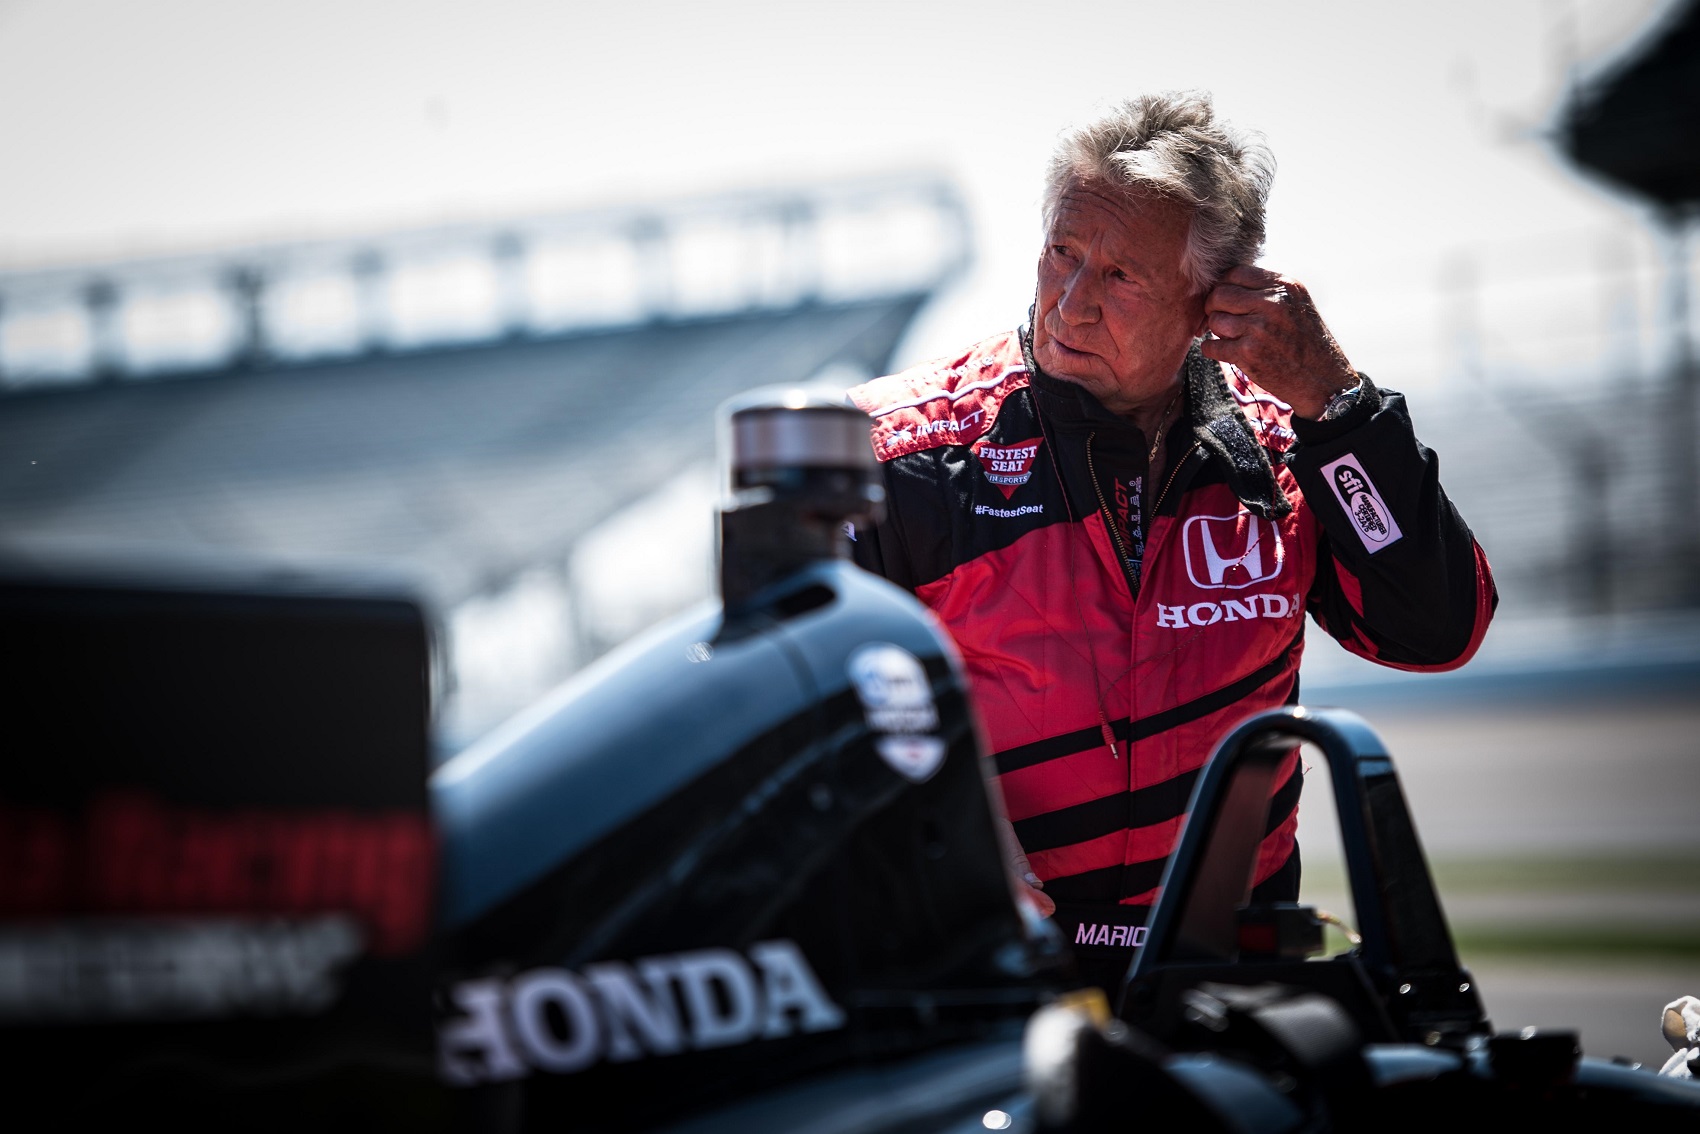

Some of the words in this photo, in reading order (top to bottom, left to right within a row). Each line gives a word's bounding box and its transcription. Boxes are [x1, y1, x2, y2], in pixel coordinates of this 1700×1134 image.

[916, 408, 985, 437] IMPACT
[979, 445, 1038, 461] FASTEST
[990, 459, 1026, 473] SEAT
[999, 475, 1029, 484] SPORTS
[1338, 470, 1364, 495] sfi
[974, 503, 1044, 518] #FastestSeat
[1360, 494, 1388, 536] MANUFACTURER
[1156, 592, 1300, 629] HONDA
[1074, 922, 1149, 947] MARIO
[437, 937, 848, 1087] HONDA
